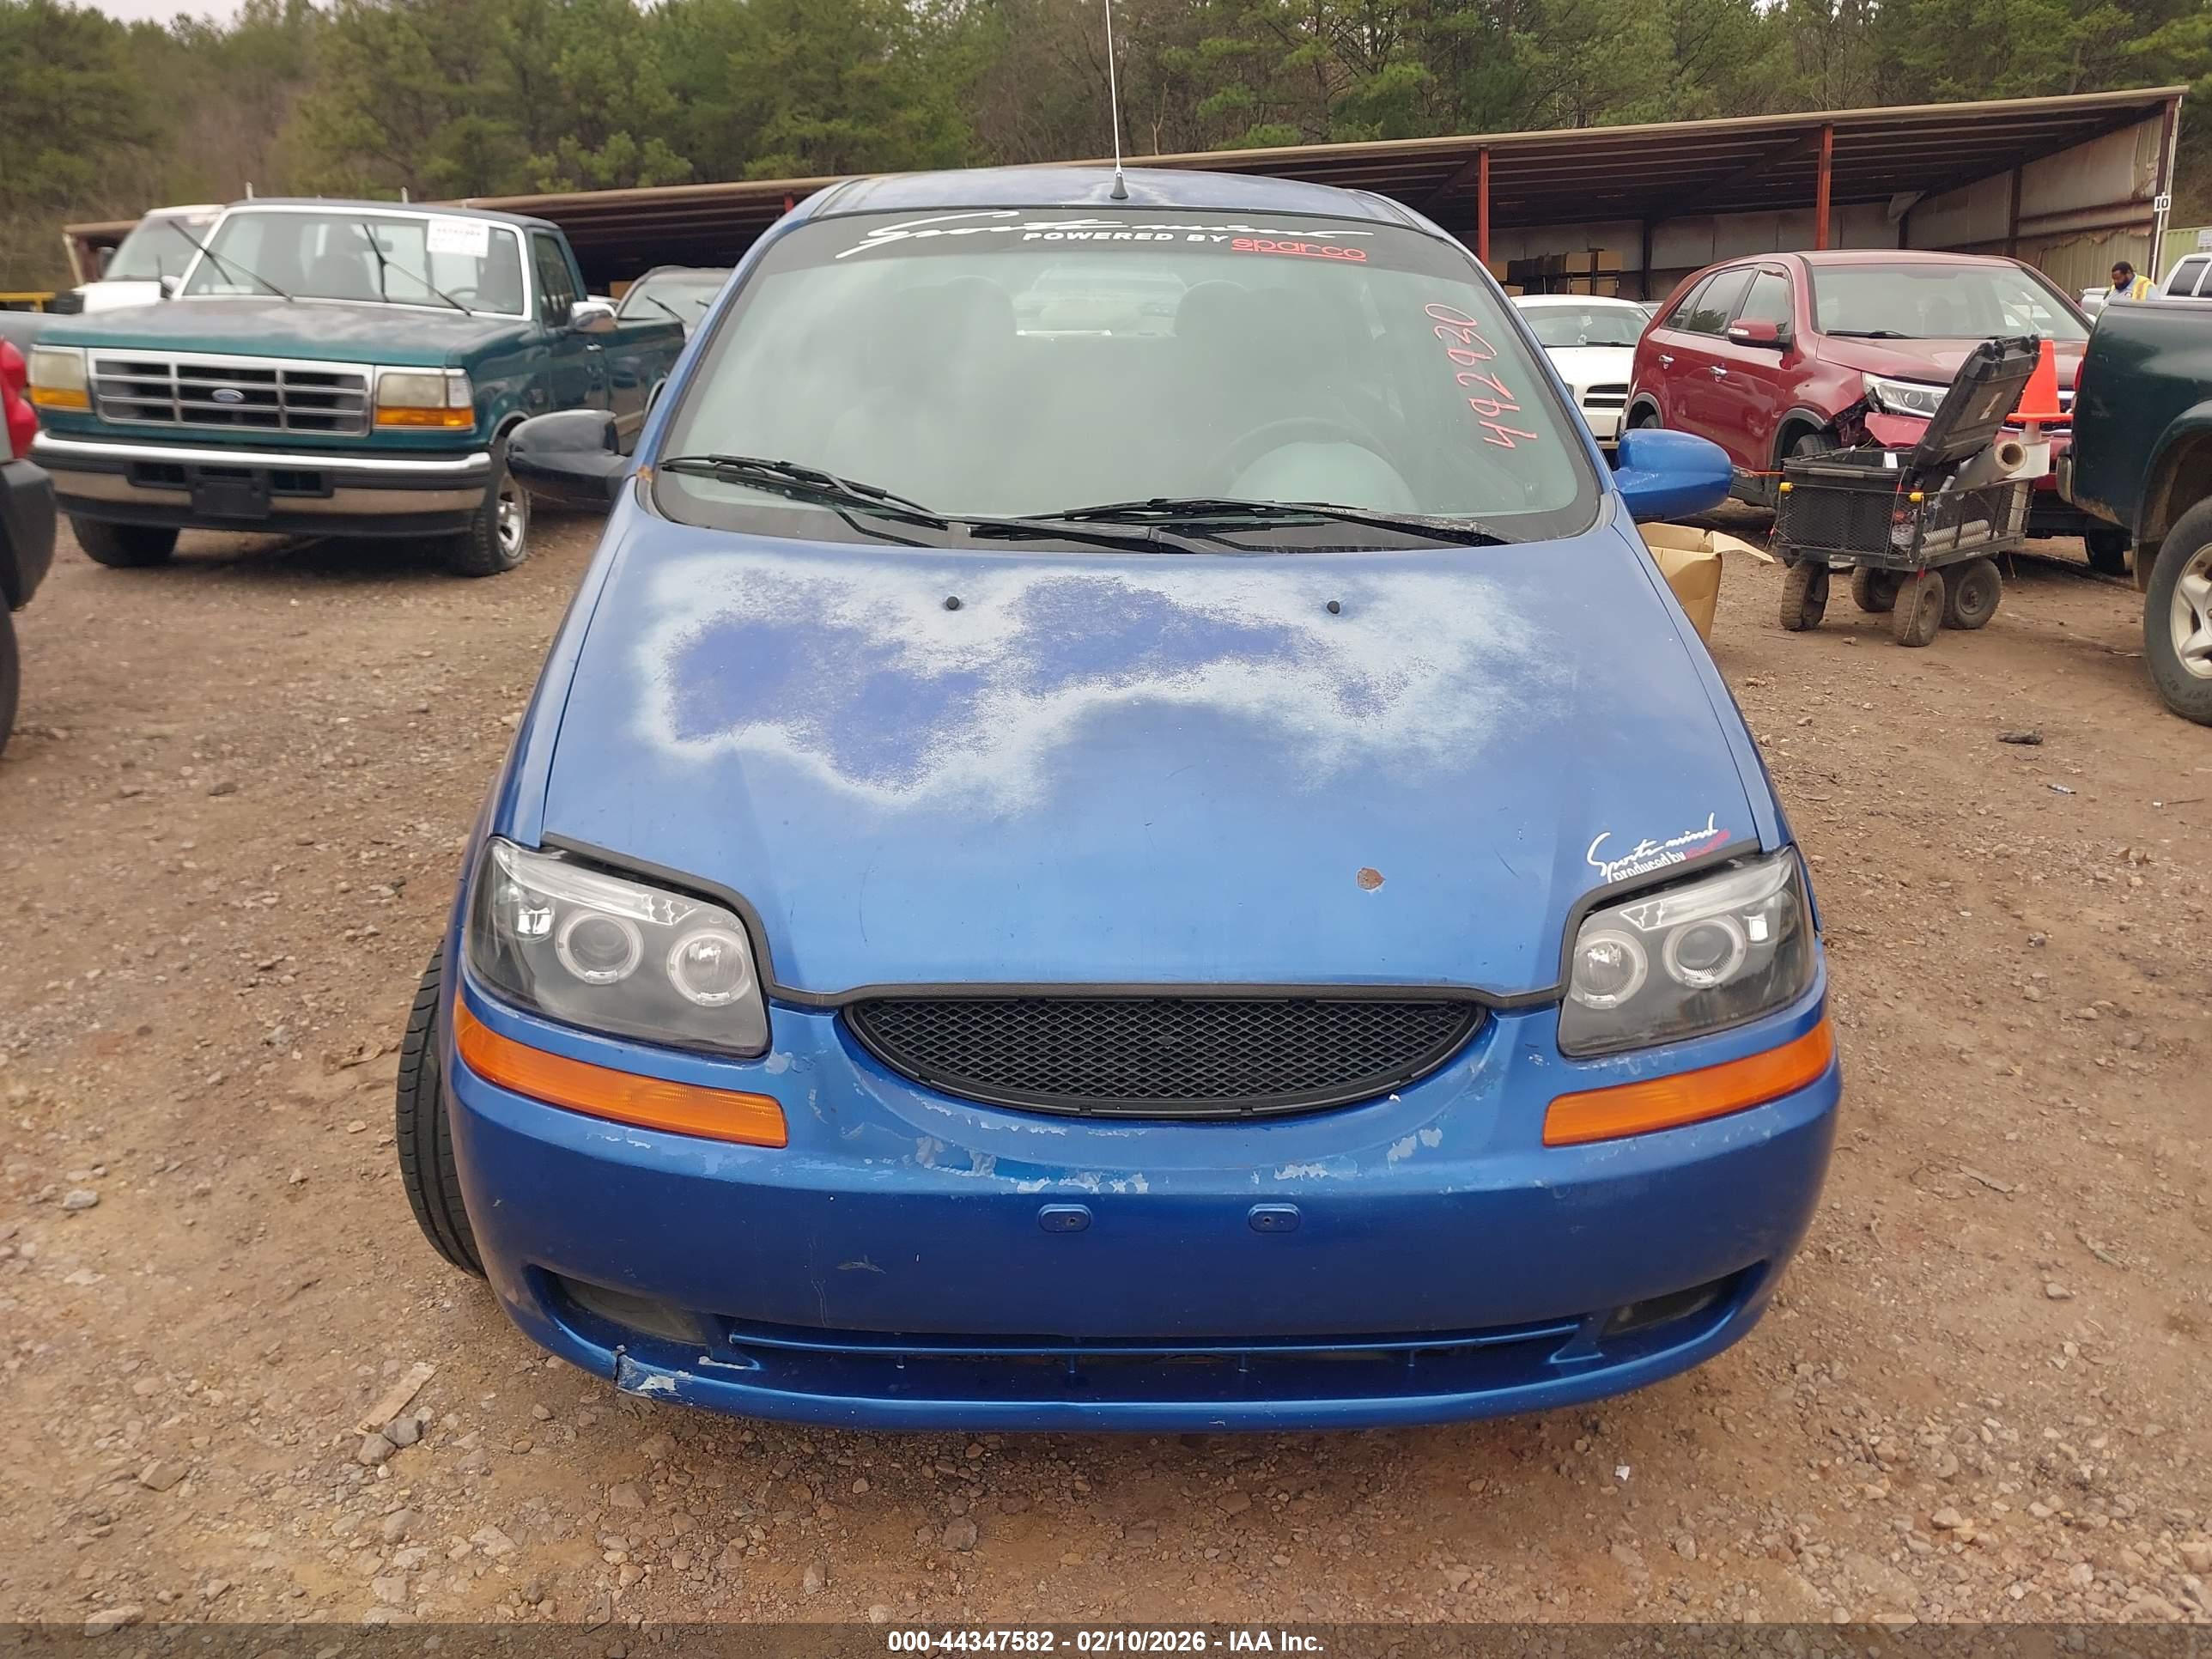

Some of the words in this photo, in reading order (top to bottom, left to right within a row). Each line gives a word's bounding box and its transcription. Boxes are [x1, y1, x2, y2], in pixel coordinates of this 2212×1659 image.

[2156, 198, 2169, 209] 10
[1023, 232, 1175, 241] POWERED
[1186, 234, 1230, 242] BY
[1231, 238, 1368, 260] sparco
[1425, 303, 1538, 449] 492930
[1612, 851, 1673, 881] produced
